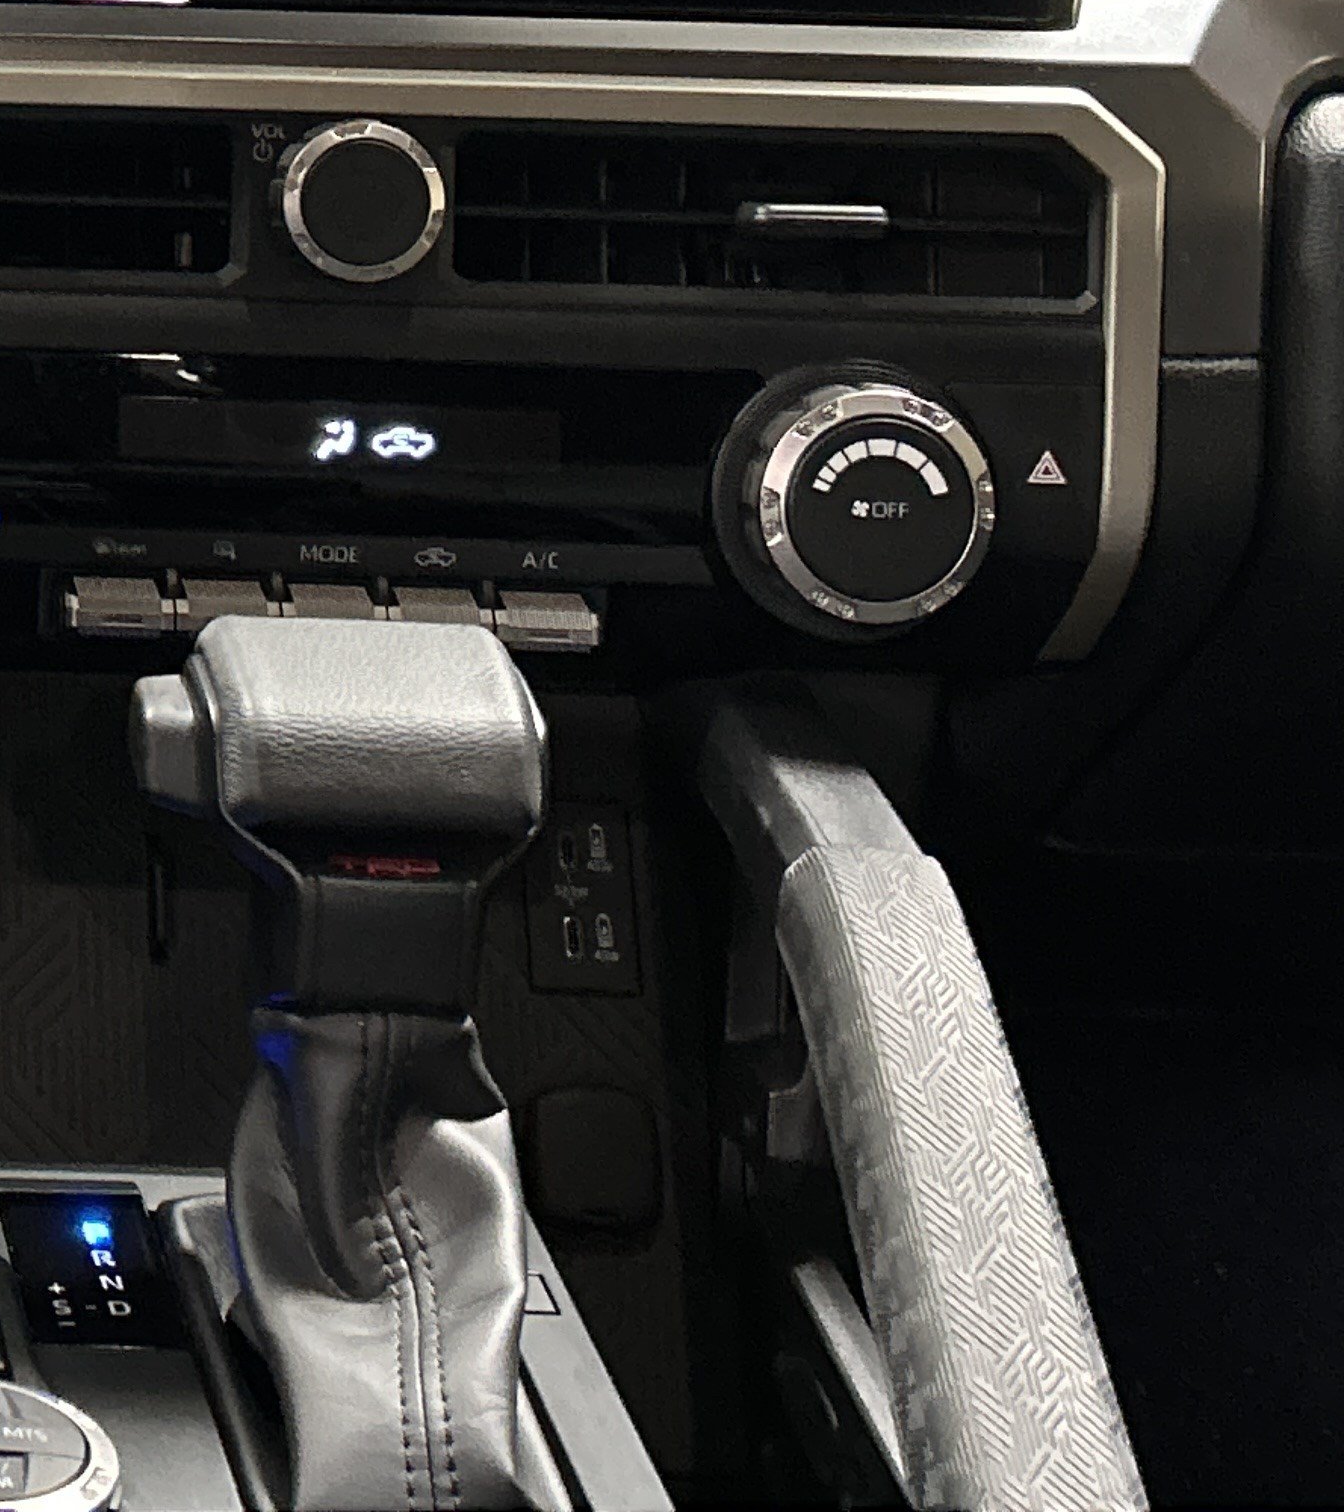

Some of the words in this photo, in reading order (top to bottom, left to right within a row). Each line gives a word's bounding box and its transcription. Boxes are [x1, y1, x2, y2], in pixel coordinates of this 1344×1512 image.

[871, 501, 910, 519] OFF
[300, 545, 359, 563] MODE
[522, 551, 559, 569] A/C
[90, 1249, 116, 1267] R
[99, 1274, 125, 1291] N
[52, 1299, 72, 1316] S
[108, 1300, 132, 1316] D
[2, 1426, 48, 1443] MTS
